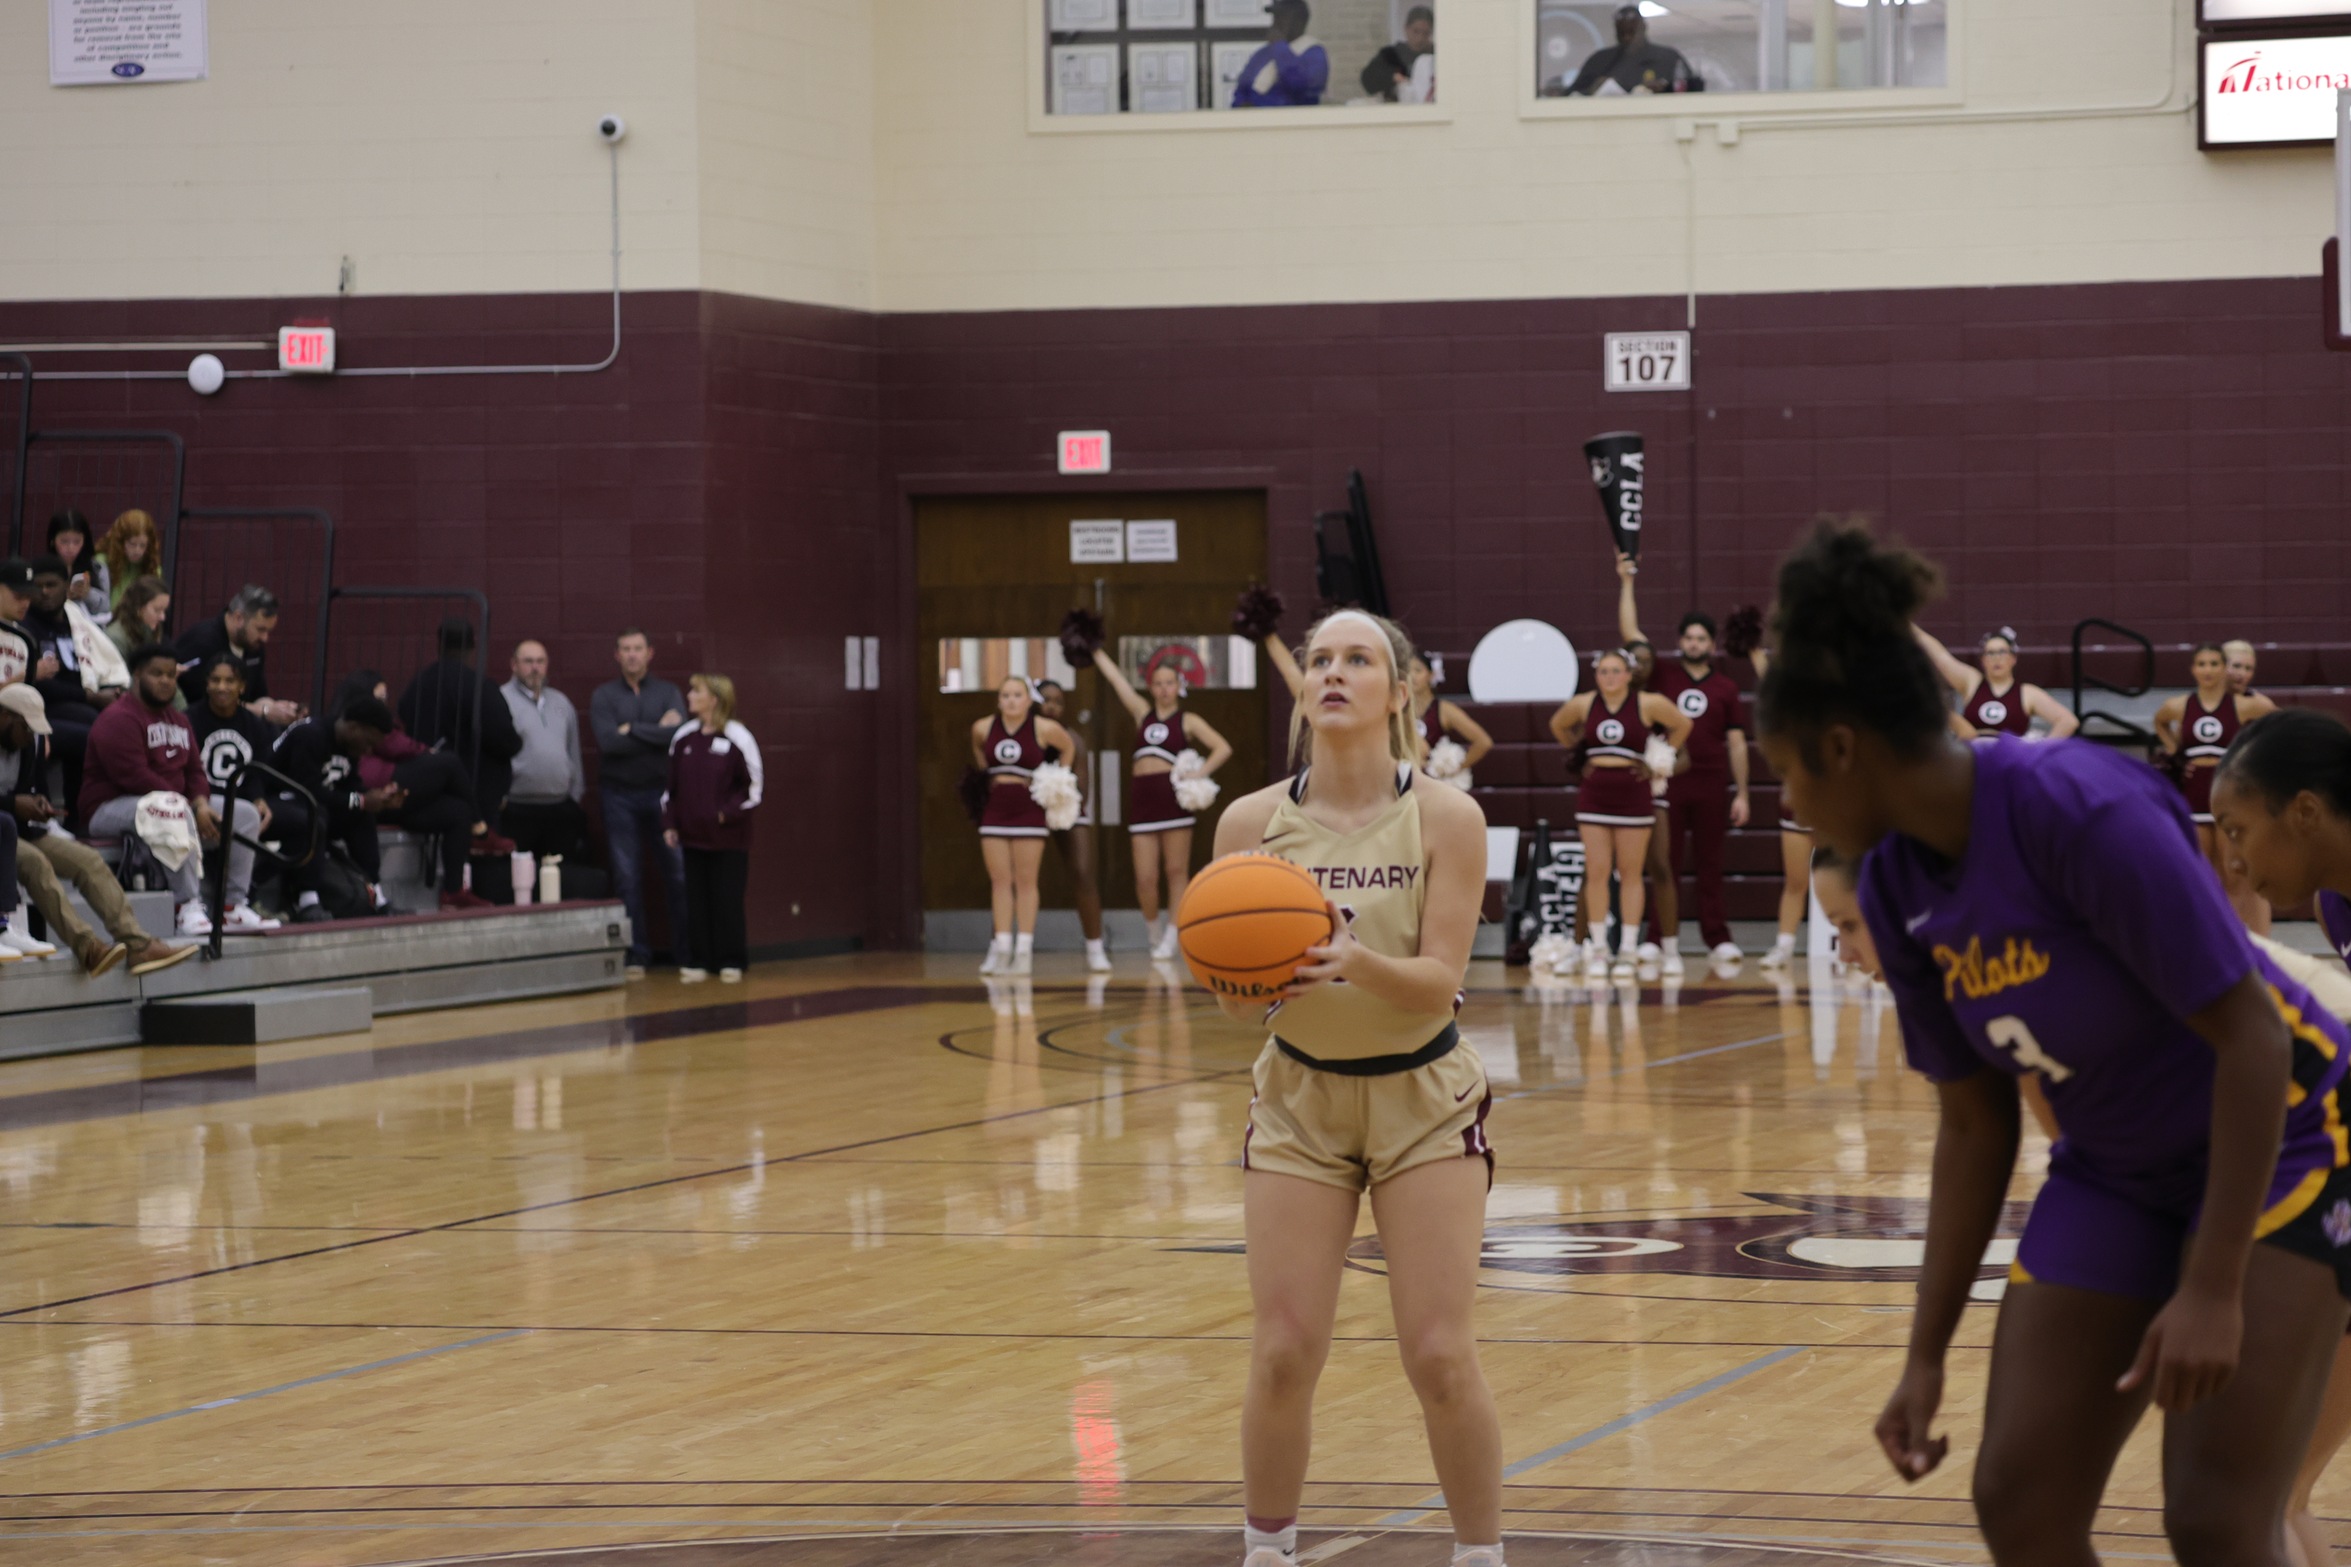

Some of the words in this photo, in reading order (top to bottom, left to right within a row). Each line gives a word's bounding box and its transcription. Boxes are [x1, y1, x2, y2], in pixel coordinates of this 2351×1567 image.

[287, 333, 324, 365] EXIT
[1618, 341, 1676, 353] SECTION
[1619, 355, 1675, 381] 107
[1065, 437, 1102, 470] EXIT
[1683, 695, 1700, 712] C
[1602, 725, 1617, 740] C
[2199, 721, 2215, 737] C
[212, 744, 238, 779] C
[1001, 744, 1014, 758] C
[1932, 933, 2050, 1002] Pilots
